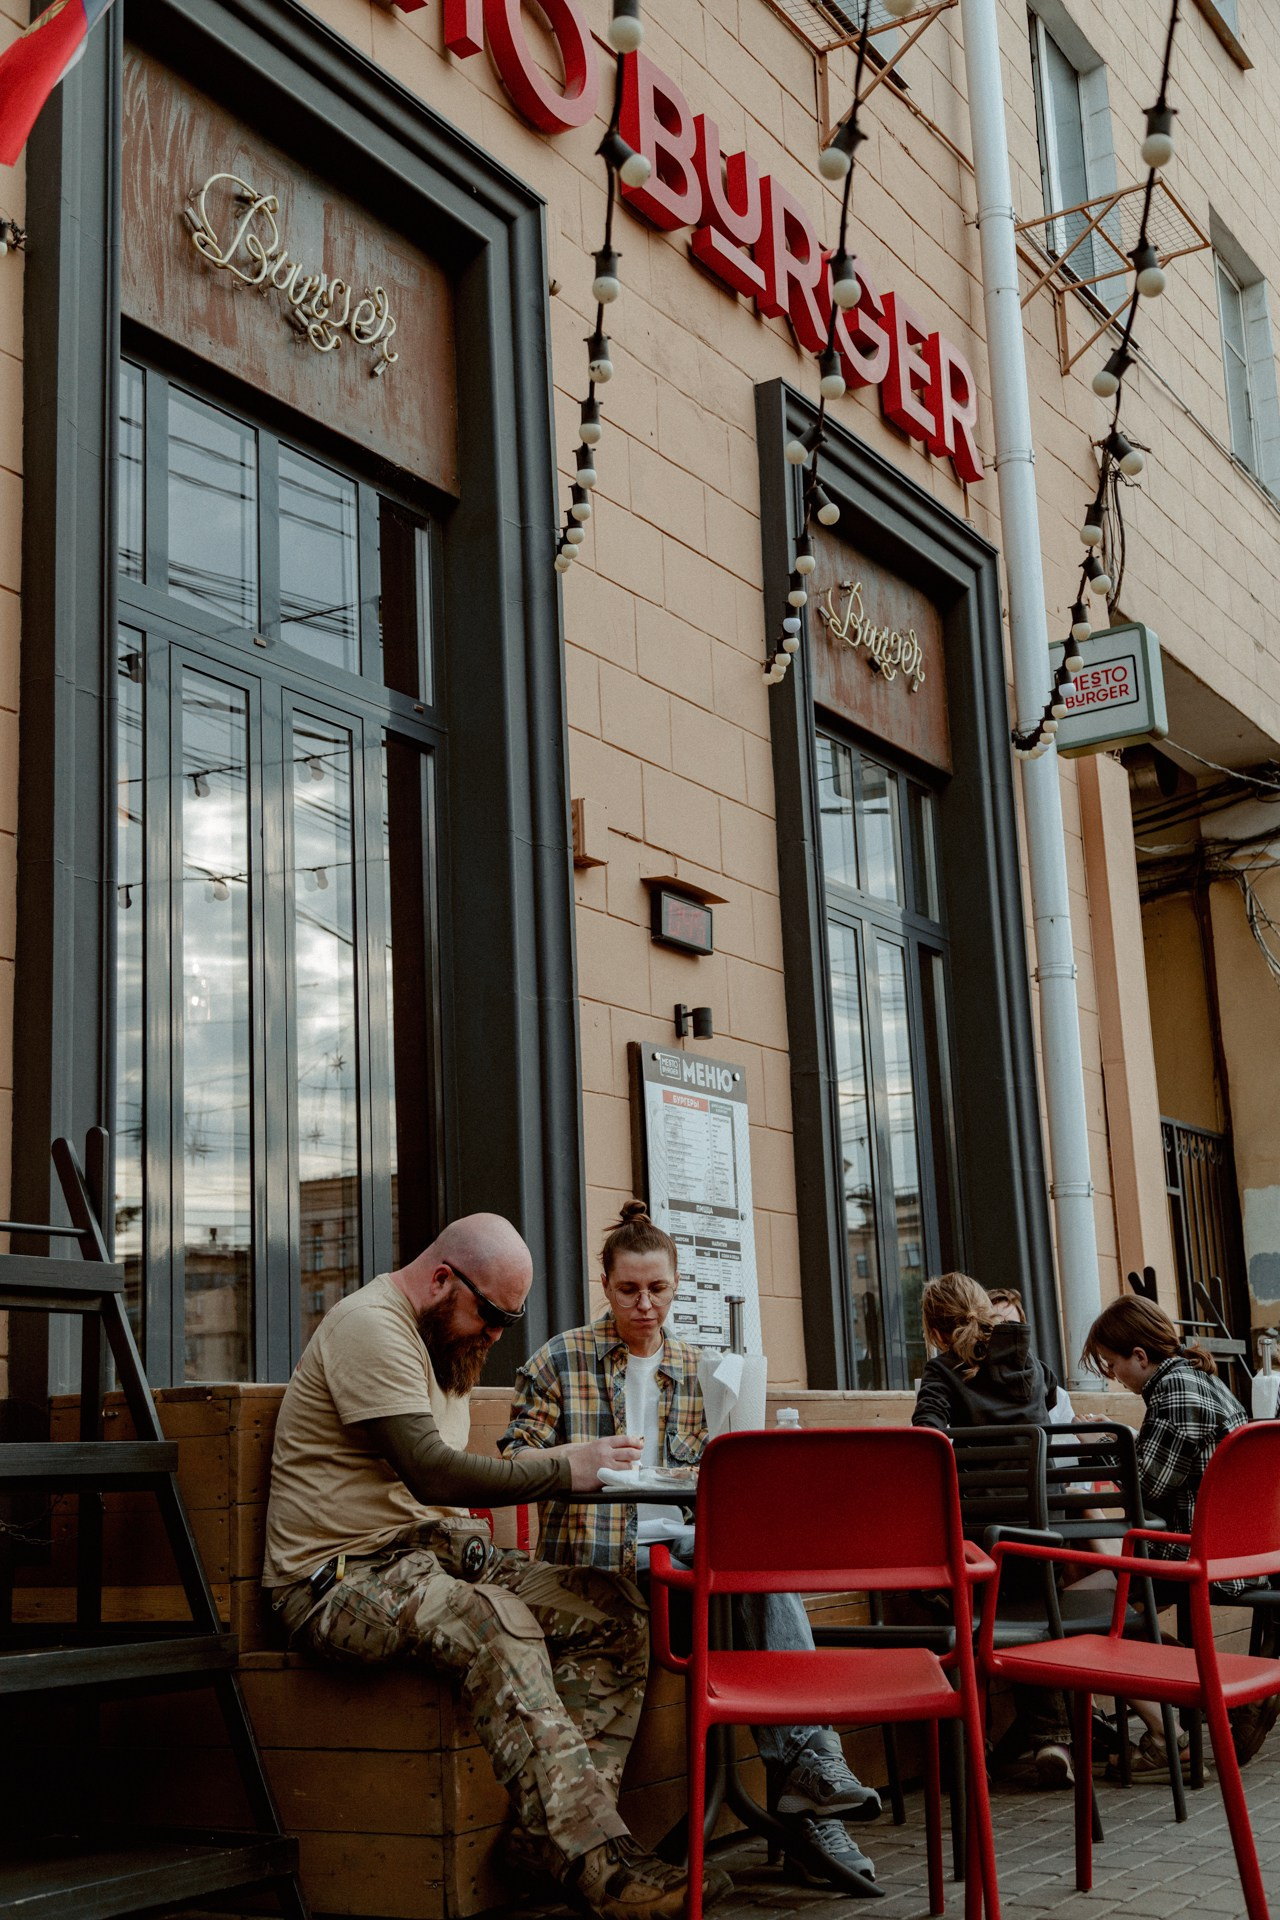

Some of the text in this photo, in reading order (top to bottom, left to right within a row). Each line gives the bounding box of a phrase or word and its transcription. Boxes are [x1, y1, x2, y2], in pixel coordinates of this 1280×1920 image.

[619, 50, 985, 483] BURGER
[1064, 683, 1130, 709] BURGER
[682, 1058, 733, 1093] МЕНЮ
[672, 1094, 700, 1109] БУРГЕРЫ
